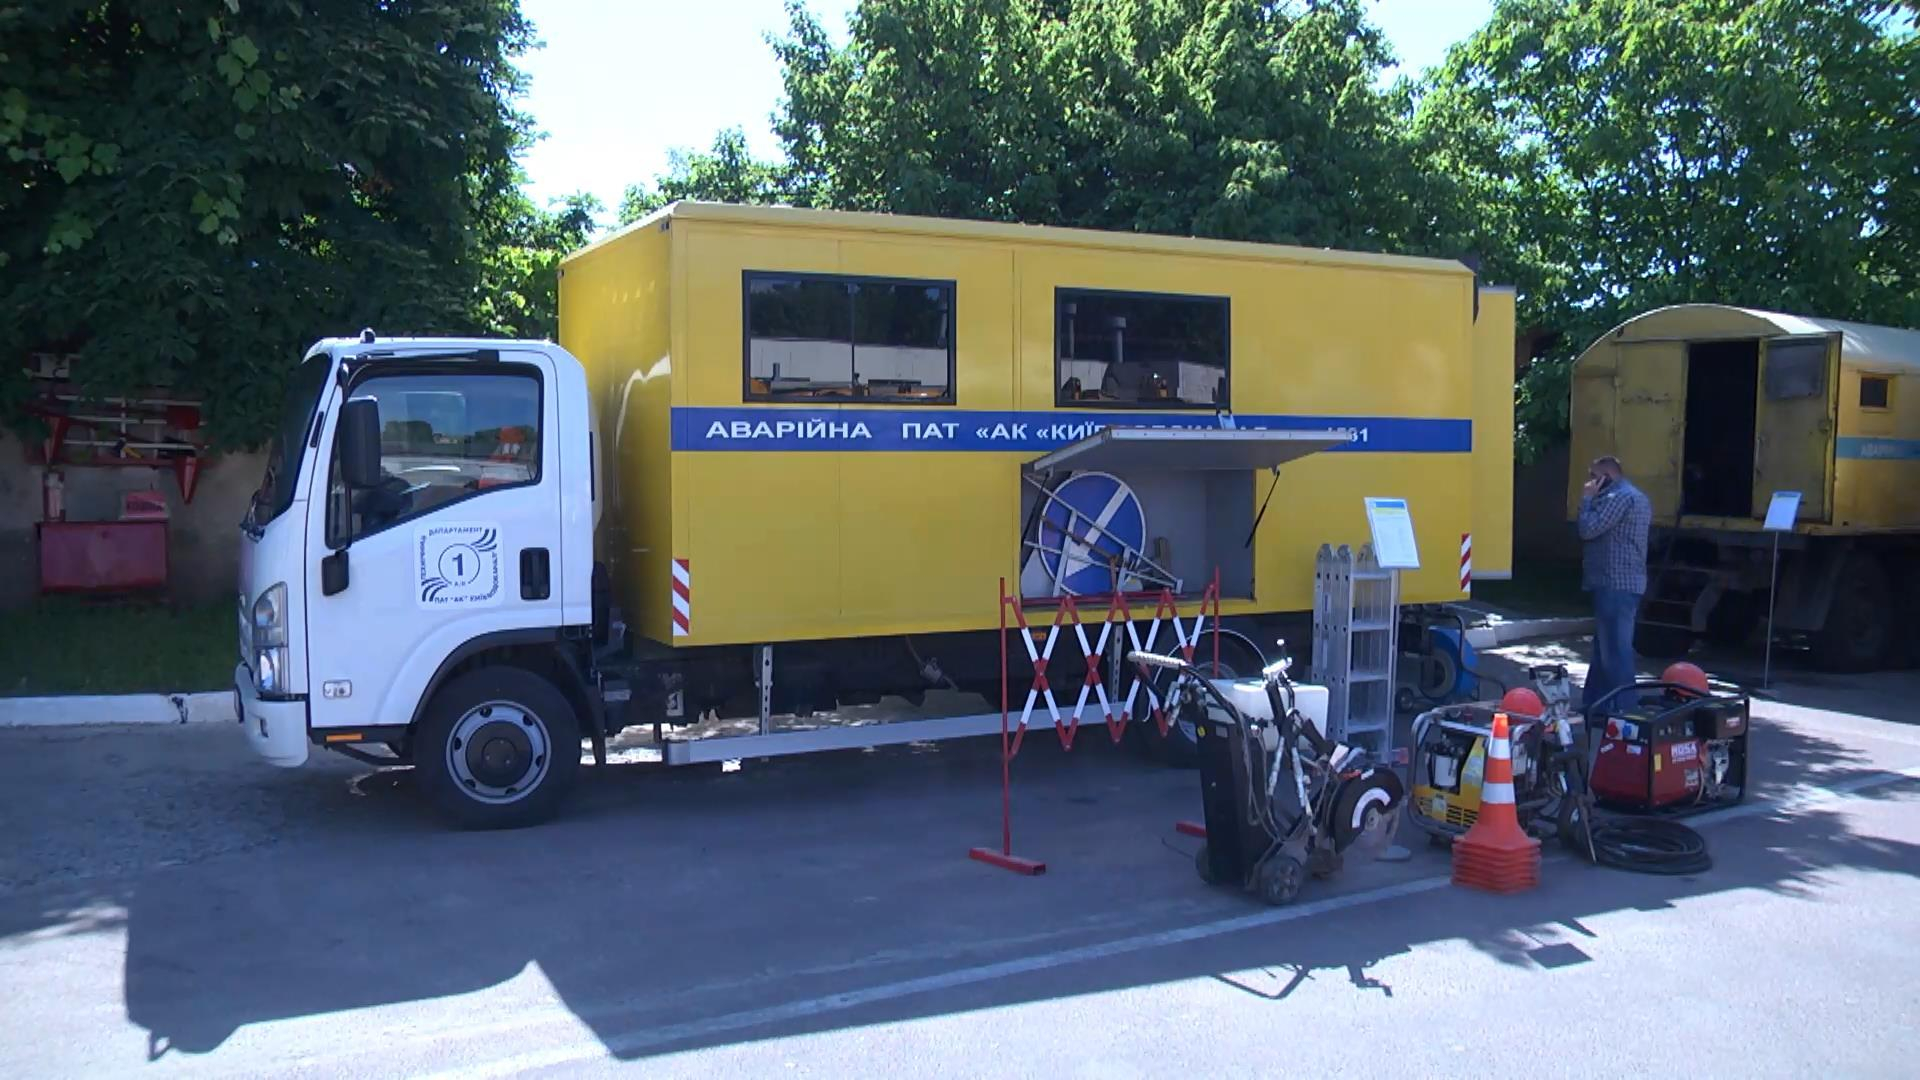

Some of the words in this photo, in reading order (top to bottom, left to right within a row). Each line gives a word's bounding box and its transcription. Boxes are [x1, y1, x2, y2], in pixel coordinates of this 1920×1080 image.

[706, 417, 873, 440] АВАРІЙНА
[902, 422, 960, 440] ПАТ
[975, 422, 1028, 441] «АК
[452, 552, 464, 576] 1
